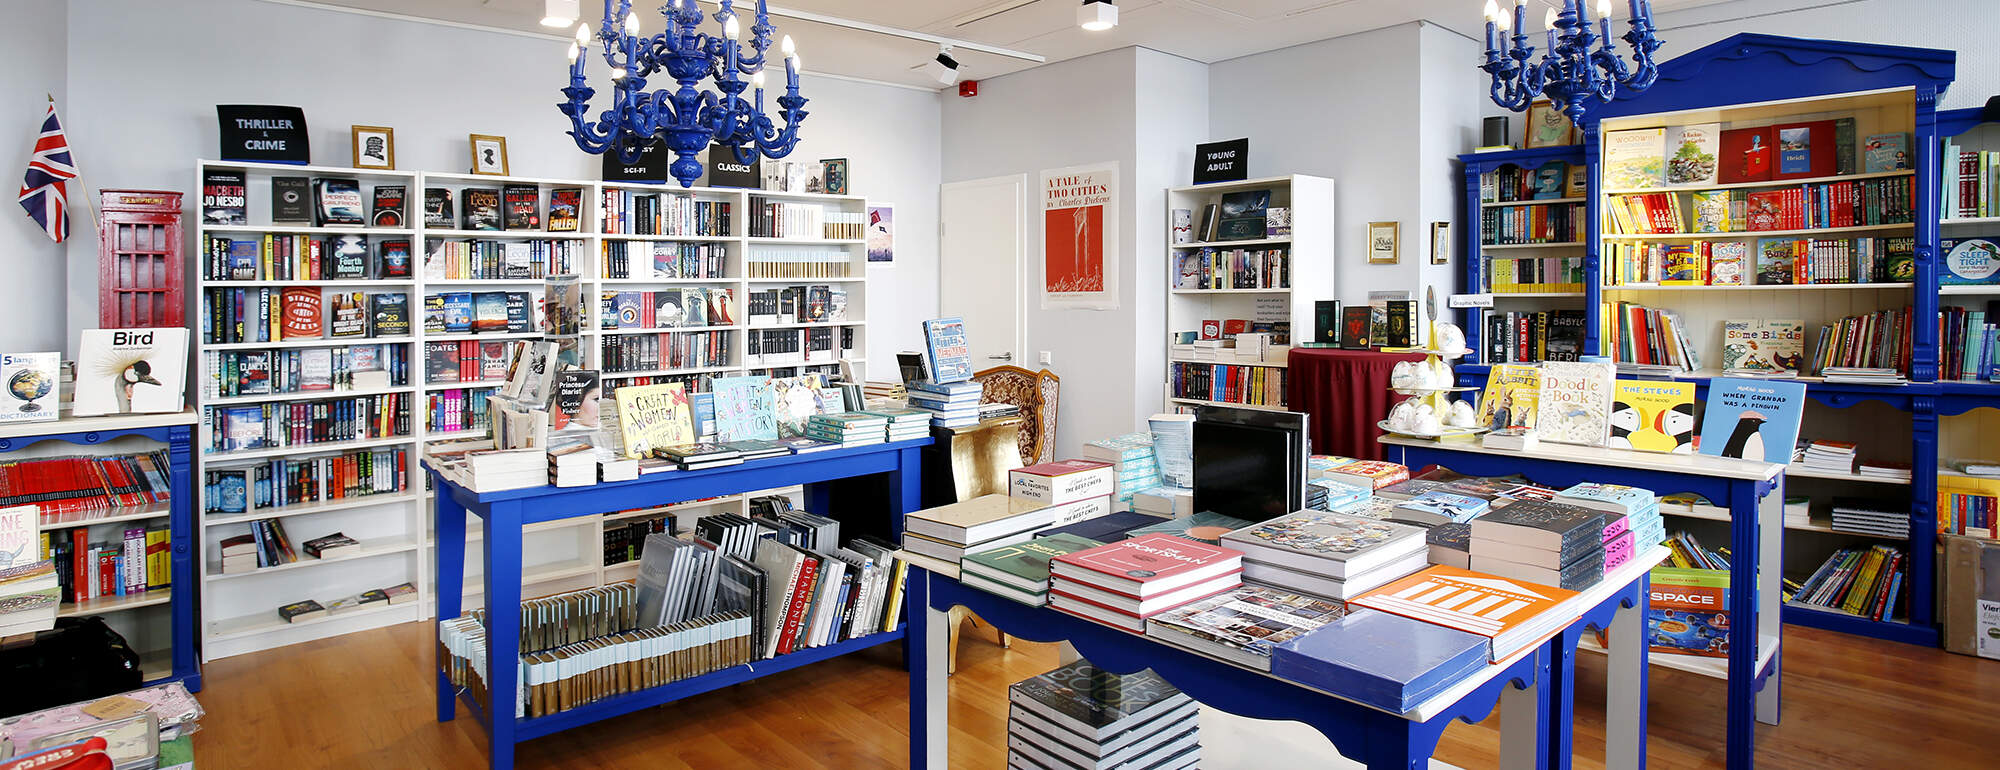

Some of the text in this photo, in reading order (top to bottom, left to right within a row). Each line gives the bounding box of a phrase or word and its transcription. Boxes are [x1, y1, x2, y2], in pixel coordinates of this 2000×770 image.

[235, 118, 294, 130] THRILLER
[244, 140, 286, 151] CRIME
[1207, 150, 1236, 160] YOUNG
[717, 162, 751, 173] CLASSICS
[1206, 162, 1233, 172] ADULT
[1048, 179, 1054, 188] A
[1056, 176, 1080, 187] TALE
[203, 185, 245, 197] MACBETH
[1048, 184, 1108, 199] TWO CITIES
[203, 196, 215, 206] JO
[549, 218, 578, 231] FALLEN
[1959, 258, 1990, 266] TIGHT
[386, 314, 398, 322] 29
[113, 331, 154, 346] Bird
[1728, 330, 1801, 340] Some Birds
[430, 344, 458, 352] OATES
[3, 356, 12, 366] 5
[1495, 375, 1538, 387] RABBIT
[1546, 376, 1599, 390] Doodle
[1623, 386, 1681, 396] THE STEVES
[636, 393, 669, 411] GREAT
[1552, 390, 1589, 404] Book
[1722, 392, 1786, 403] WHEN GRANDAD
[1724, 400, 1738, 408] WAS
[0, 411, 56, 420] DICTIONARY
[787, 565, 816, 635] DIAMONDS
[1480, 587, 1537, 603] Museum
[1650, 592, 1714, 605] SPACE
